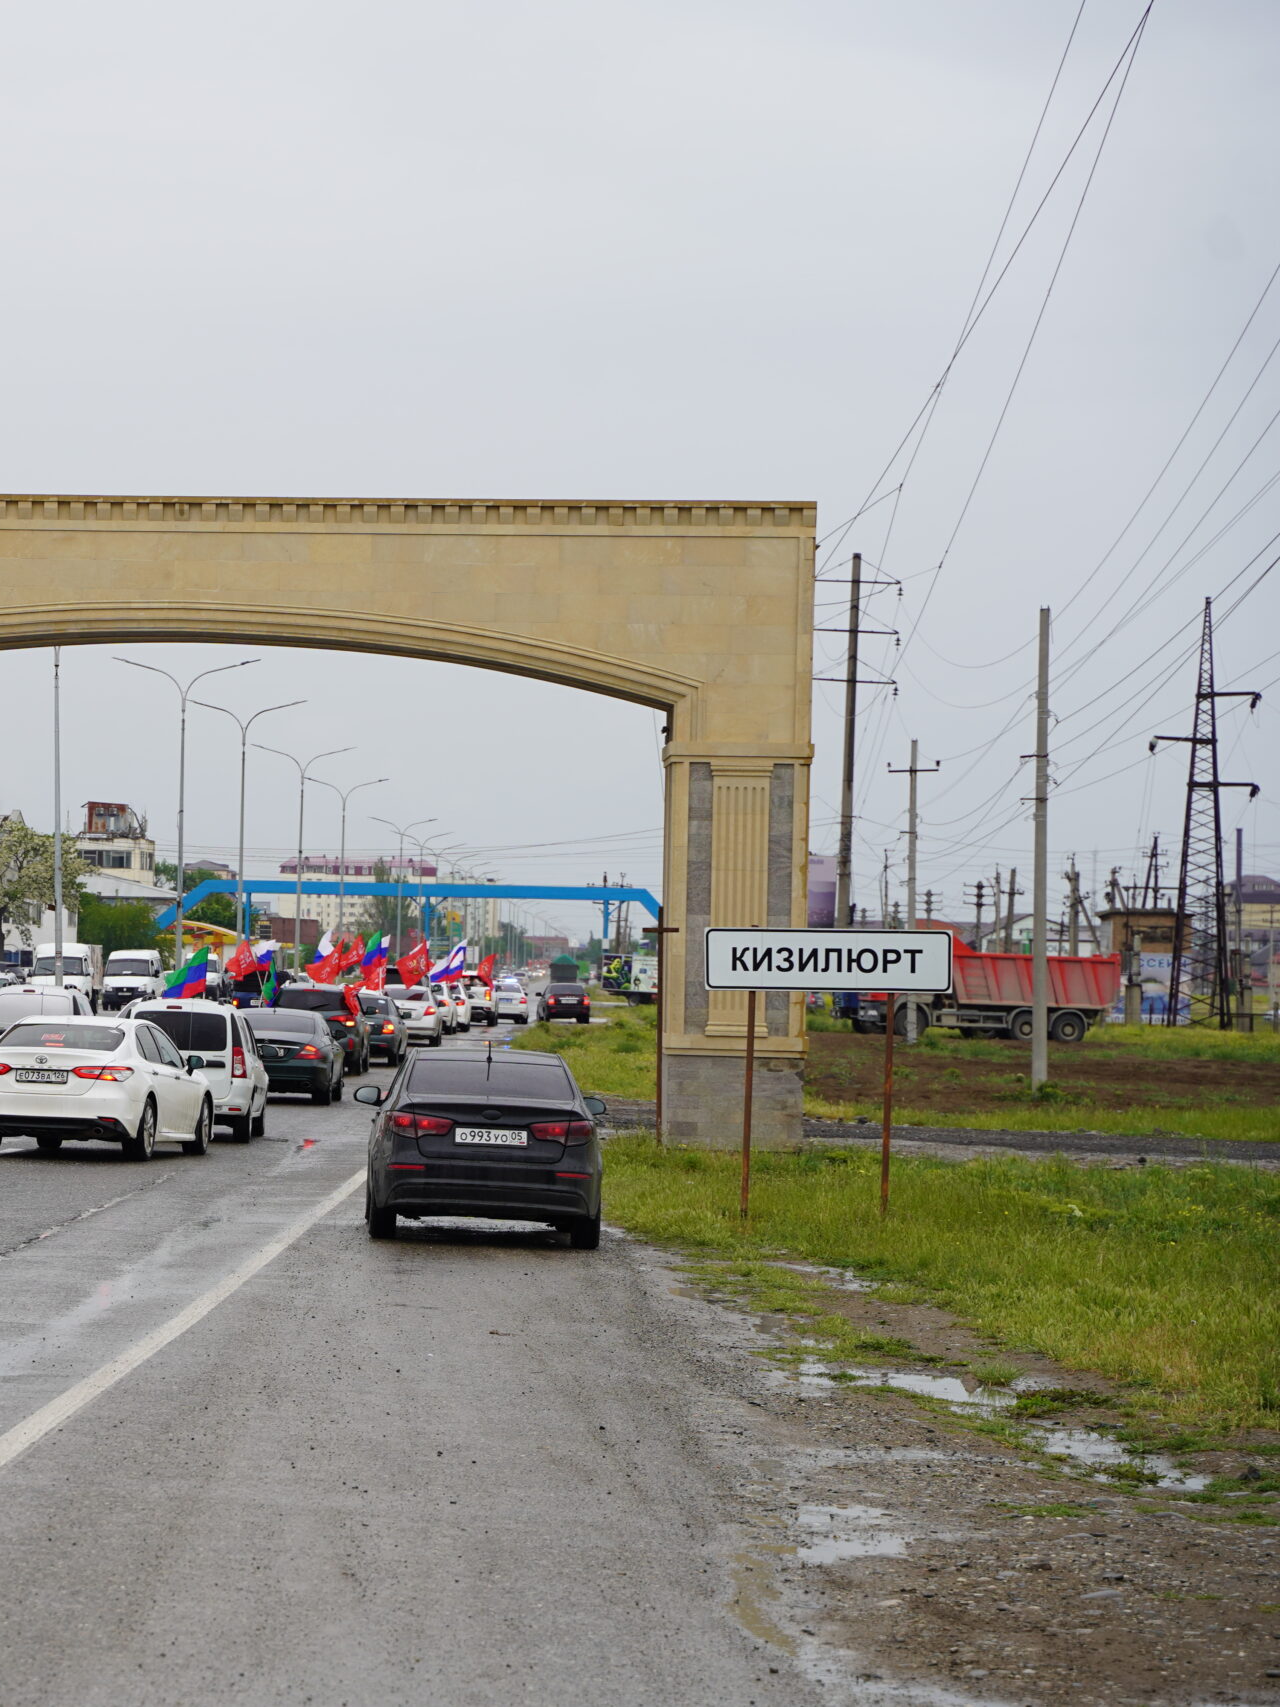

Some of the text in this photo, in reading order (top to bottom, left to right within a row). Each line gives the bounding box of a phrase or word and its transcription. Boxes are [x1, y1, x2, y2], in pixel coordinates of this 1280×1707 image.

[730, 946, 923, 974] КИЗИЛЮРТ
[19, 1070, 65, 1080] Е073ВА 126
[460, 1130, 523, 1143] О993УО 05
